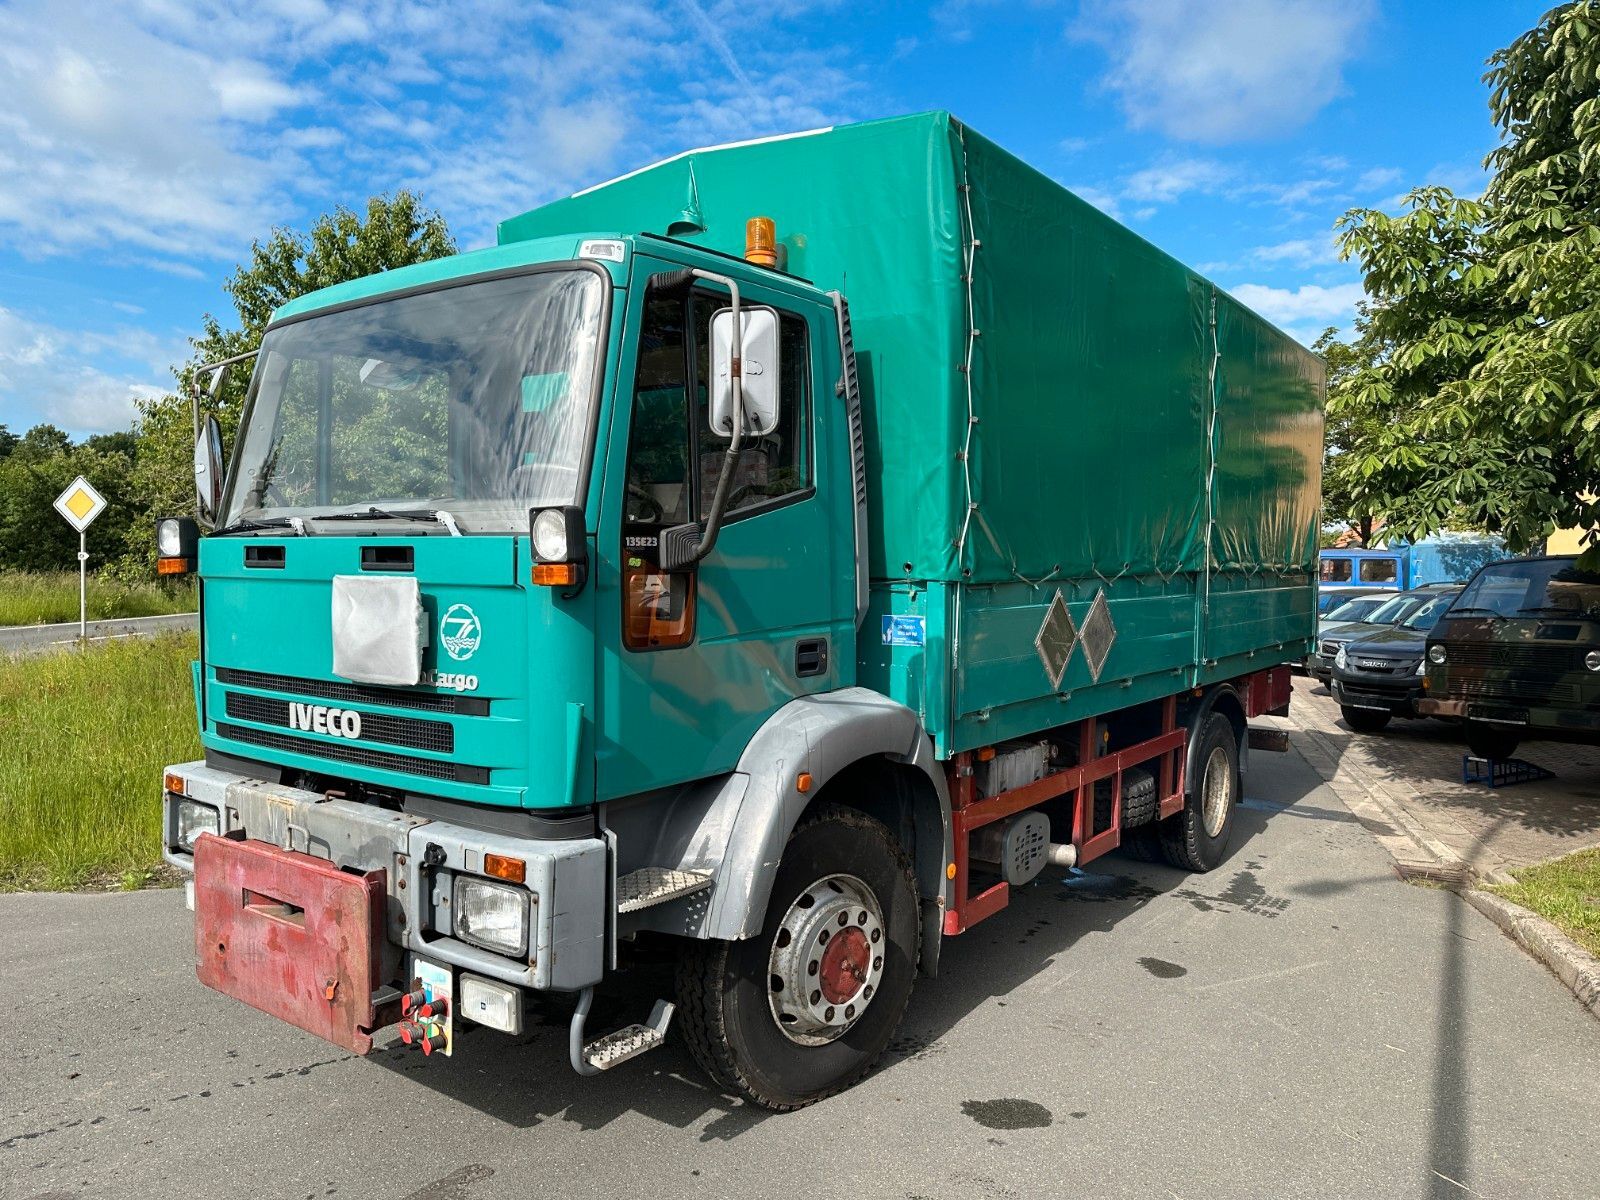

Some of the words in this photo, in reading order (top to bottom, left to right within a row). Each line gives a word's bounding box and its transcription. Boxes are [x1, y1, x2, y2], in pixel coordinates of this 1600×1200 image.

[625, 536, 658, 547] 135E23
[1362, 660, 1387, 668] ISUZU
[289, 702, 361, 739] IVECO
